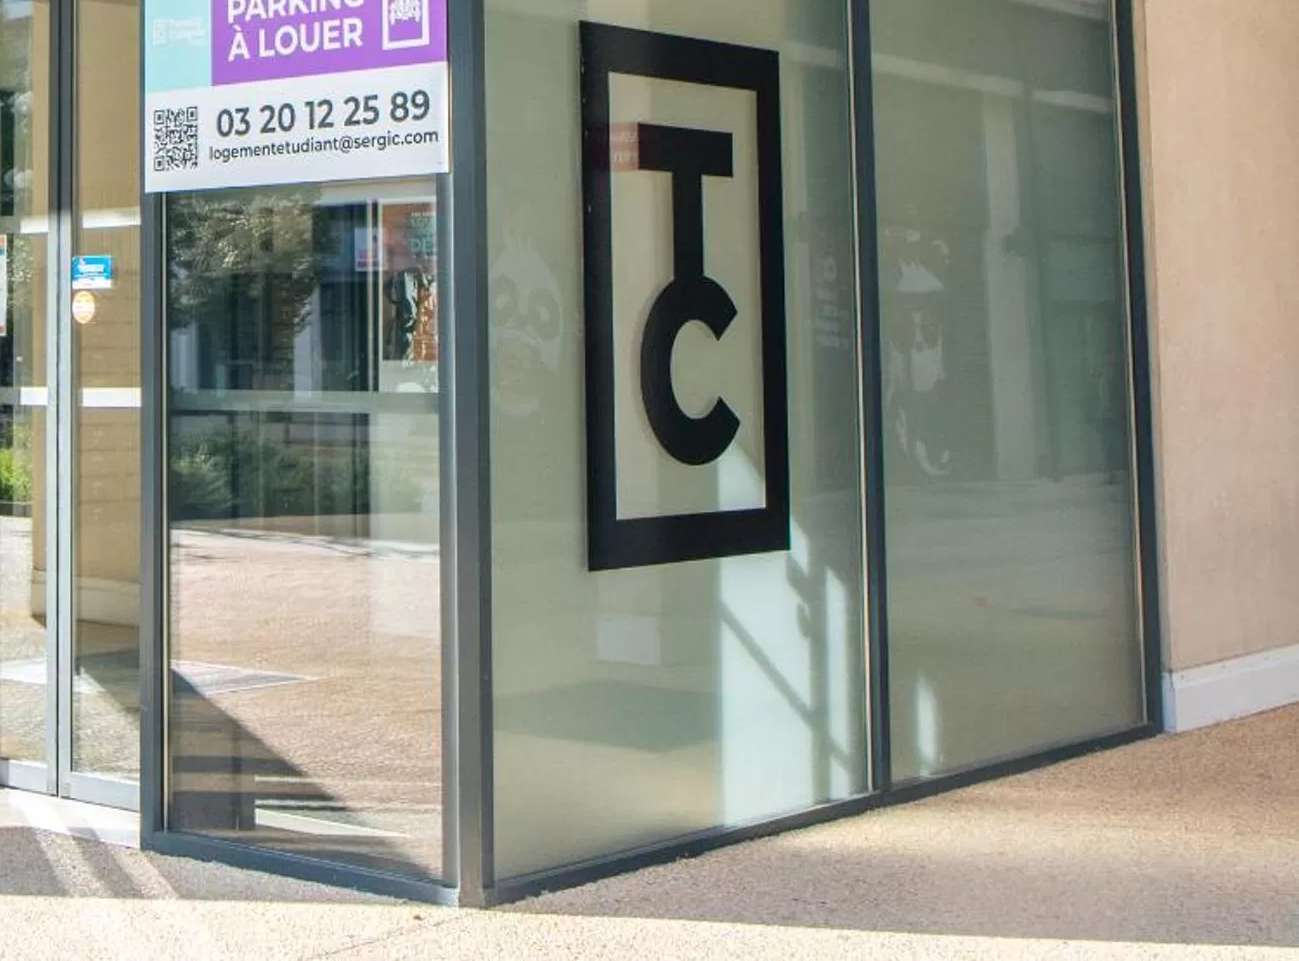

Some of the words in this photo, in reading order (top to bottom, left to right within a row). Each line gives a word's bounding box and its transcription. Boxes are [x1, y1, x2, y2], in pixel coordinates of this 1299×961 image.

[227, 24, 251, 63] À
[258, 16, 364, 58] LOUER
[215, 106, 251, 138] 03
[259, 102, 296, 135] 20
[304, 98, 335, 130] 12
[343, 93, 380, 127] 25
[389, 89, 431, 123] 89
[209, 129, 440, 163] logementetudiant@sergic.com
